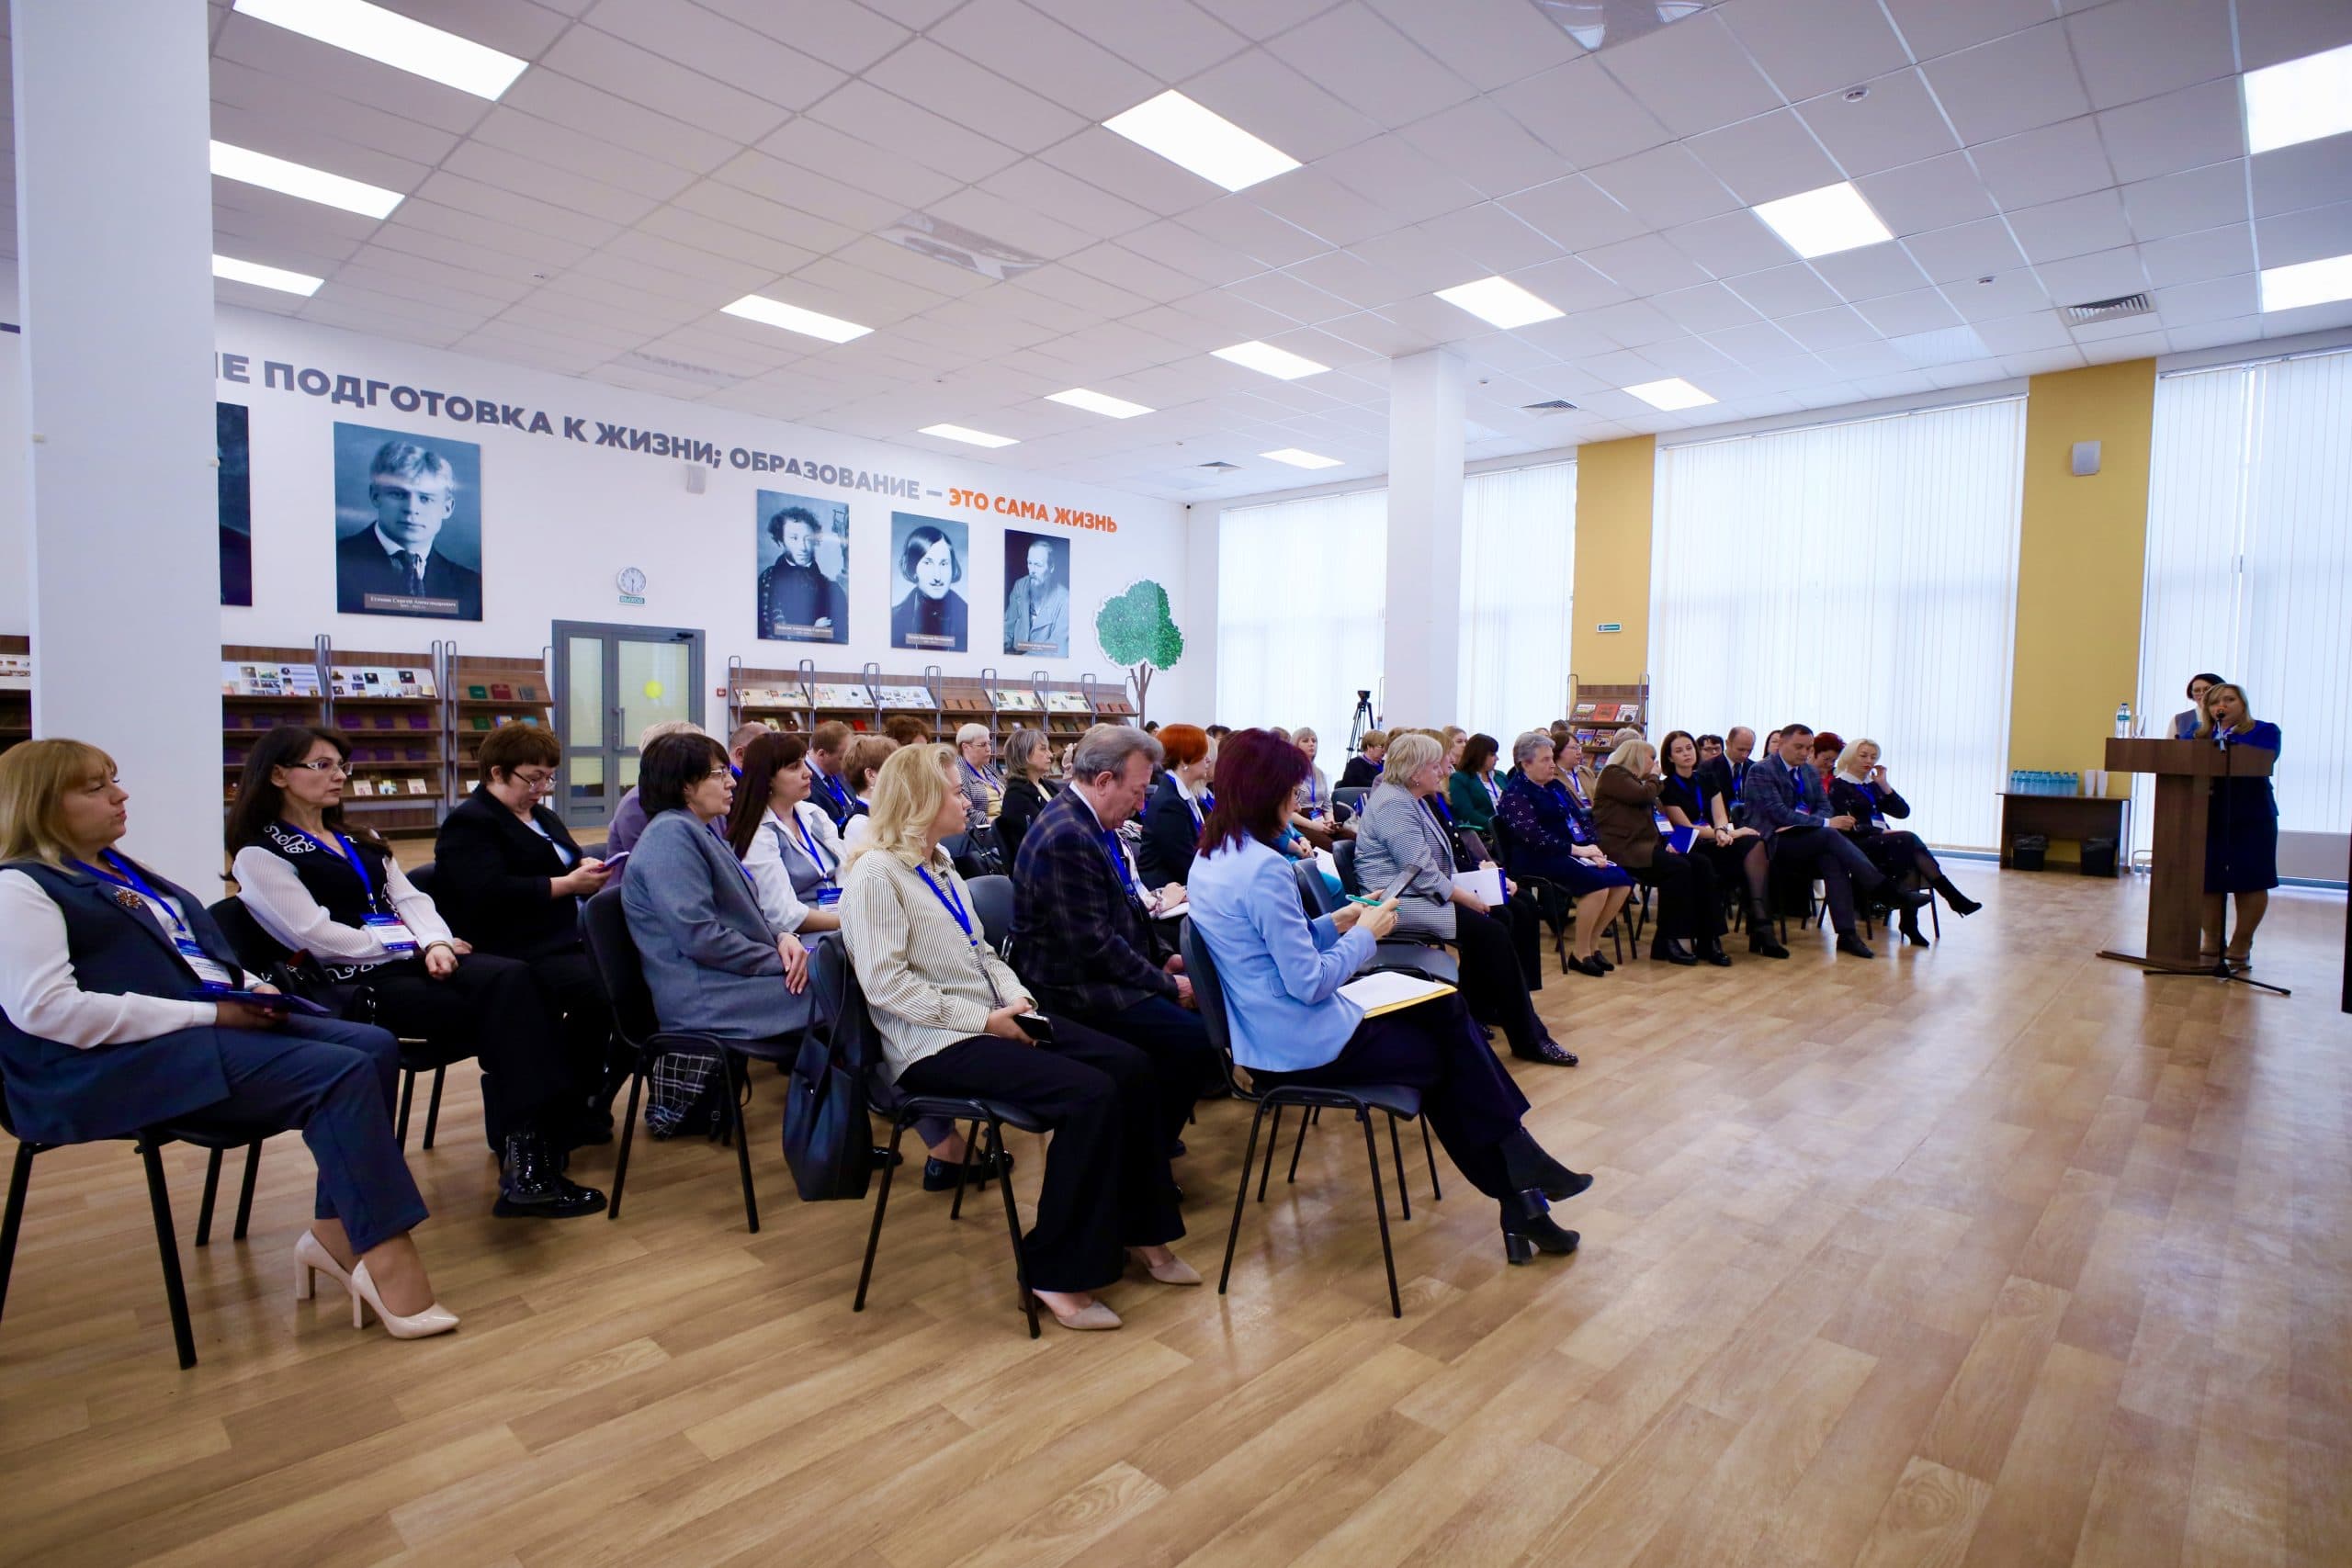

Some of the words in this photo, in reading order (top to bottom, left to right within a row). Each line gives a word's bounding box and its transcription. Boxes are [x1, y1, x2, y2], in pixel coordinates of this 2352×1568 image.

[215, 351, 250, 384] Е
[264, 360, 554, 434] ПОДГОТОВКА
[563, 416, 588, 442] К
[595, 422, 721, 468] ЖИЗНИ;
[729, 447, 920, 500] ОБРАЗОВАНИЕ
[949, 488, 989, 511] ЭТО
[994, 496, 1049, 522] САМА
[1054, 507, 1117, 534] ЖИЗНЬ
